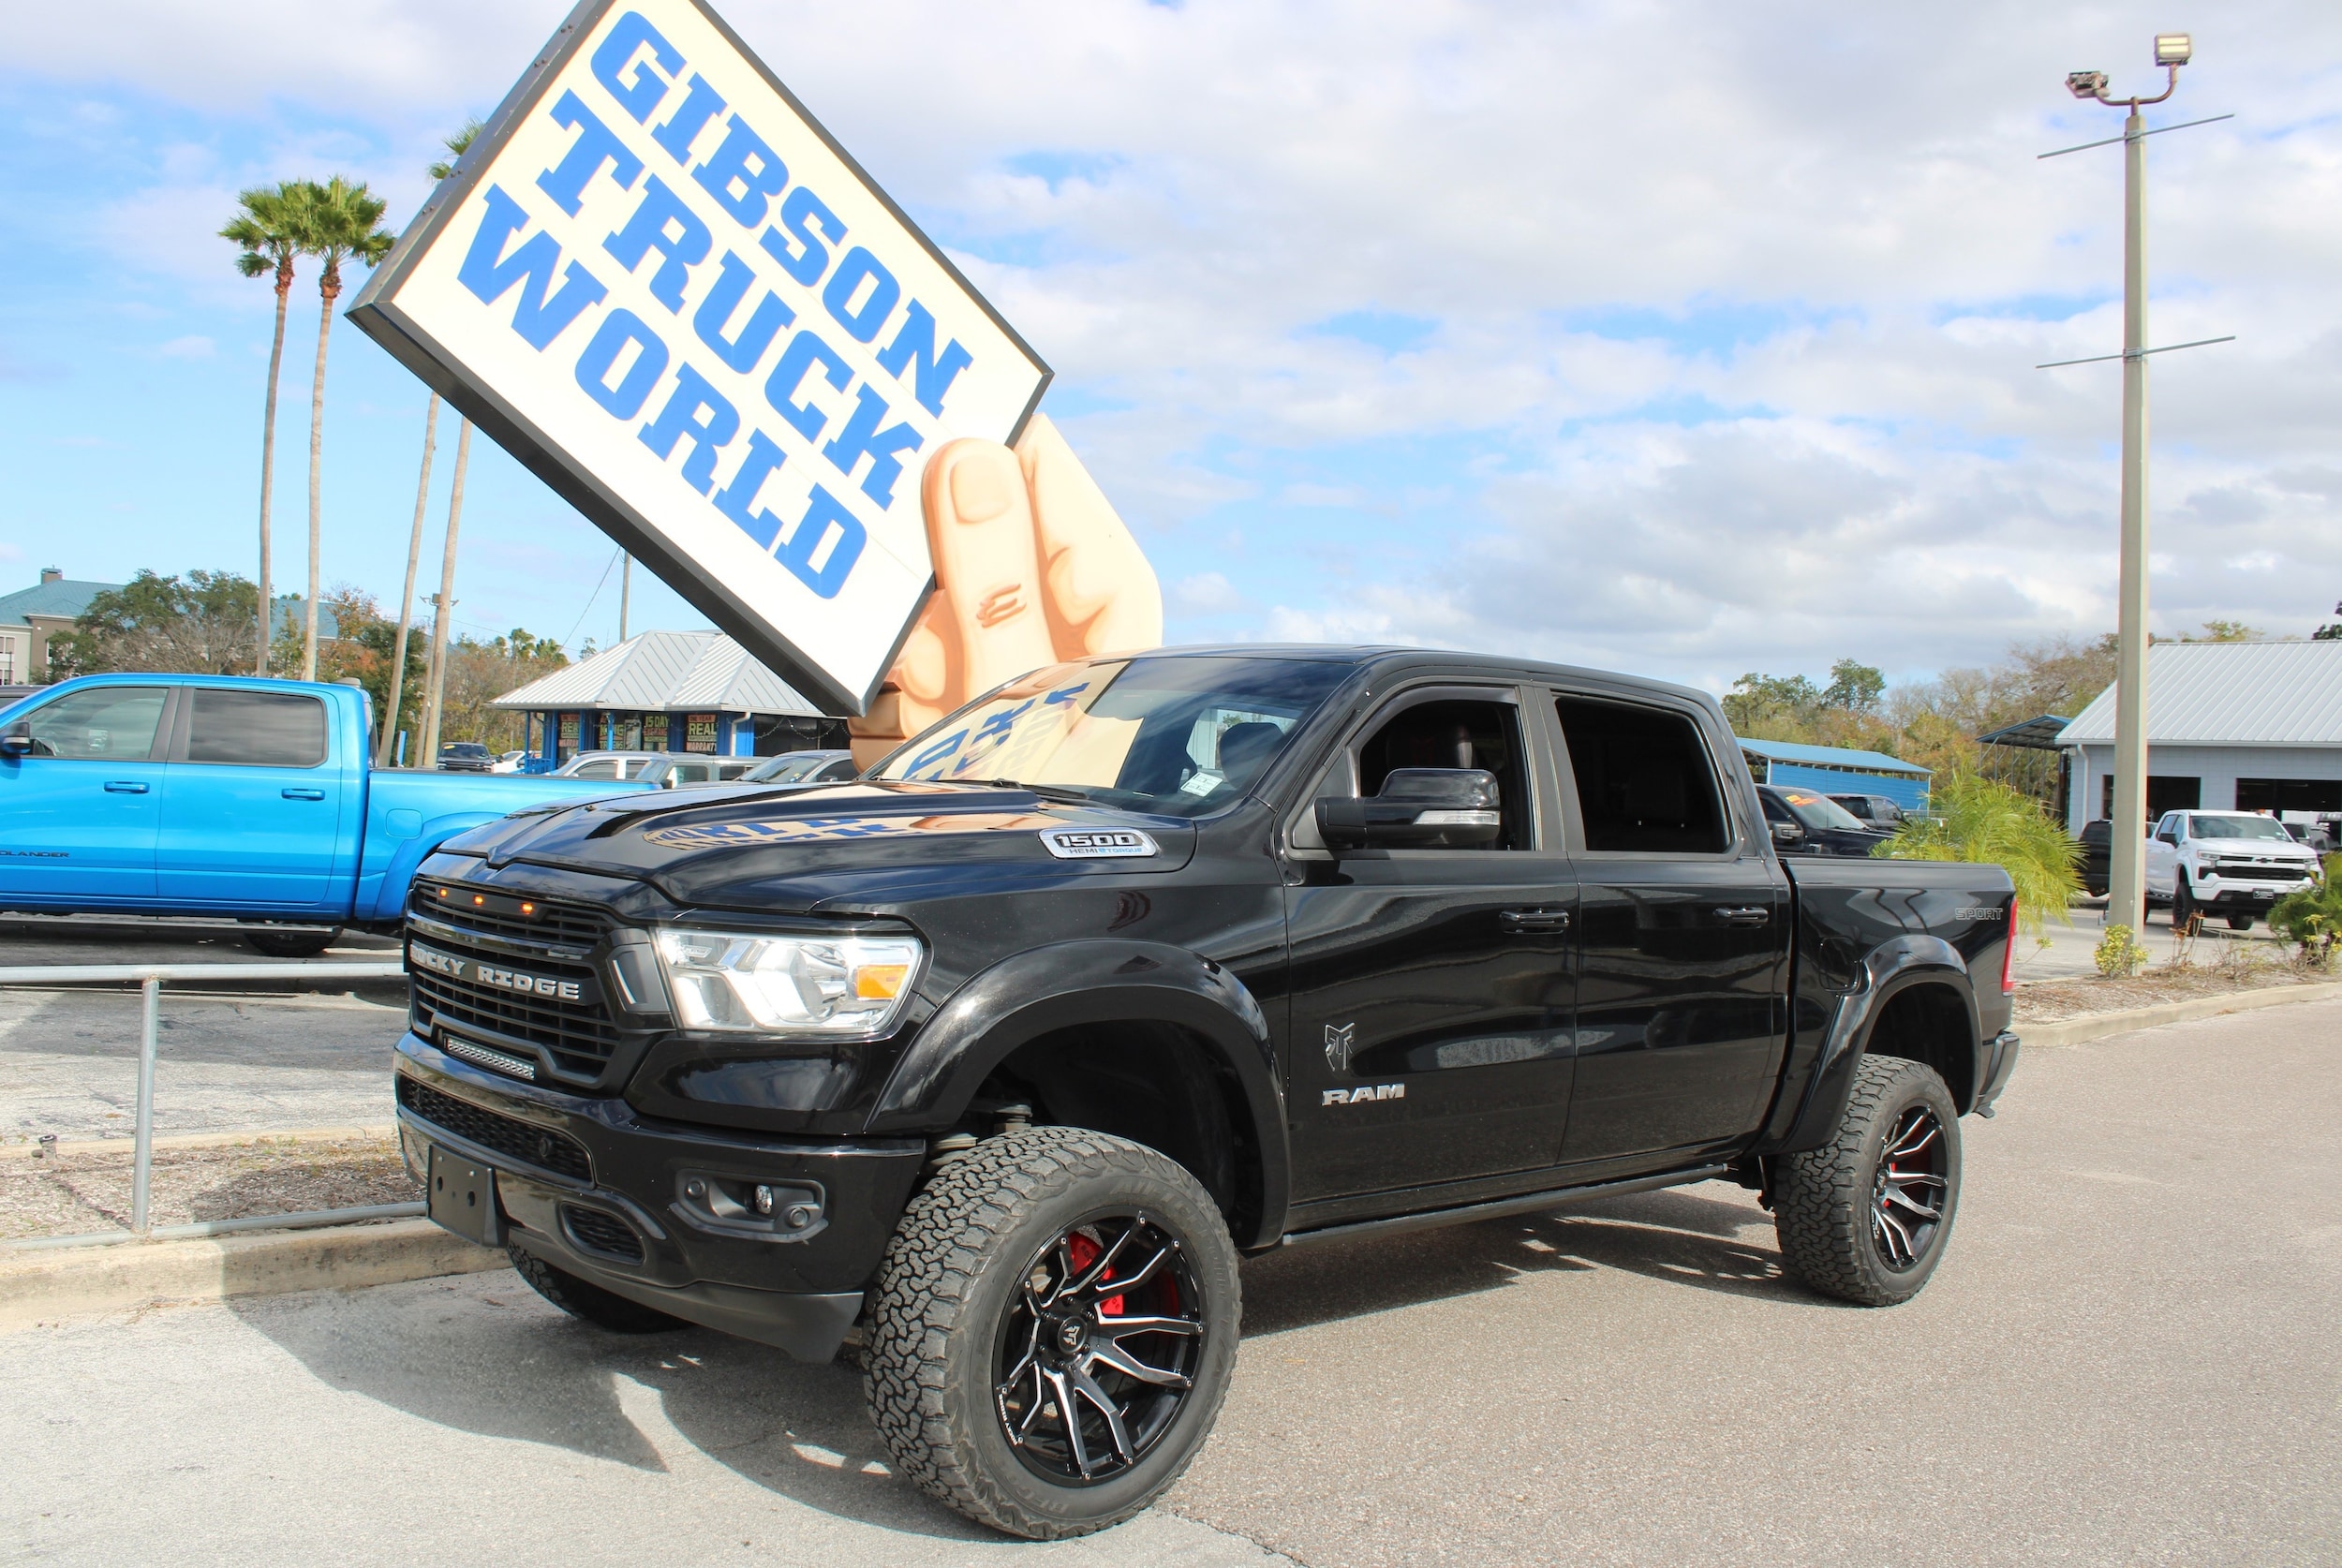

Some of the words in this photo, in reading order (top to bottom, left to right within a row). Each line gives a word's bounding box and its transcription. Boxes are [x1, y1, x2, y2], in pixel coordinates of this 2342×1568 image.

[590, 11, 974, 420] GIBSON
[535, 88, 925, 511] TRUCK
[456, 183, 867, 599] WORLD
[562, 722, 579, 732] REA
[645, 716, 654, 727] 15
[655, 716, 669, 728] DAY
[689, 722, 718, 735] REAL
[1056, 834, 1136, 847] 1500
[1954, 907, 2004, 921] SPORT
[409, 943, 466, 976] ROCKY
[477, 965, 580, 1000] RIDGE
[1321, 1083, 1405, 1106] RAM
